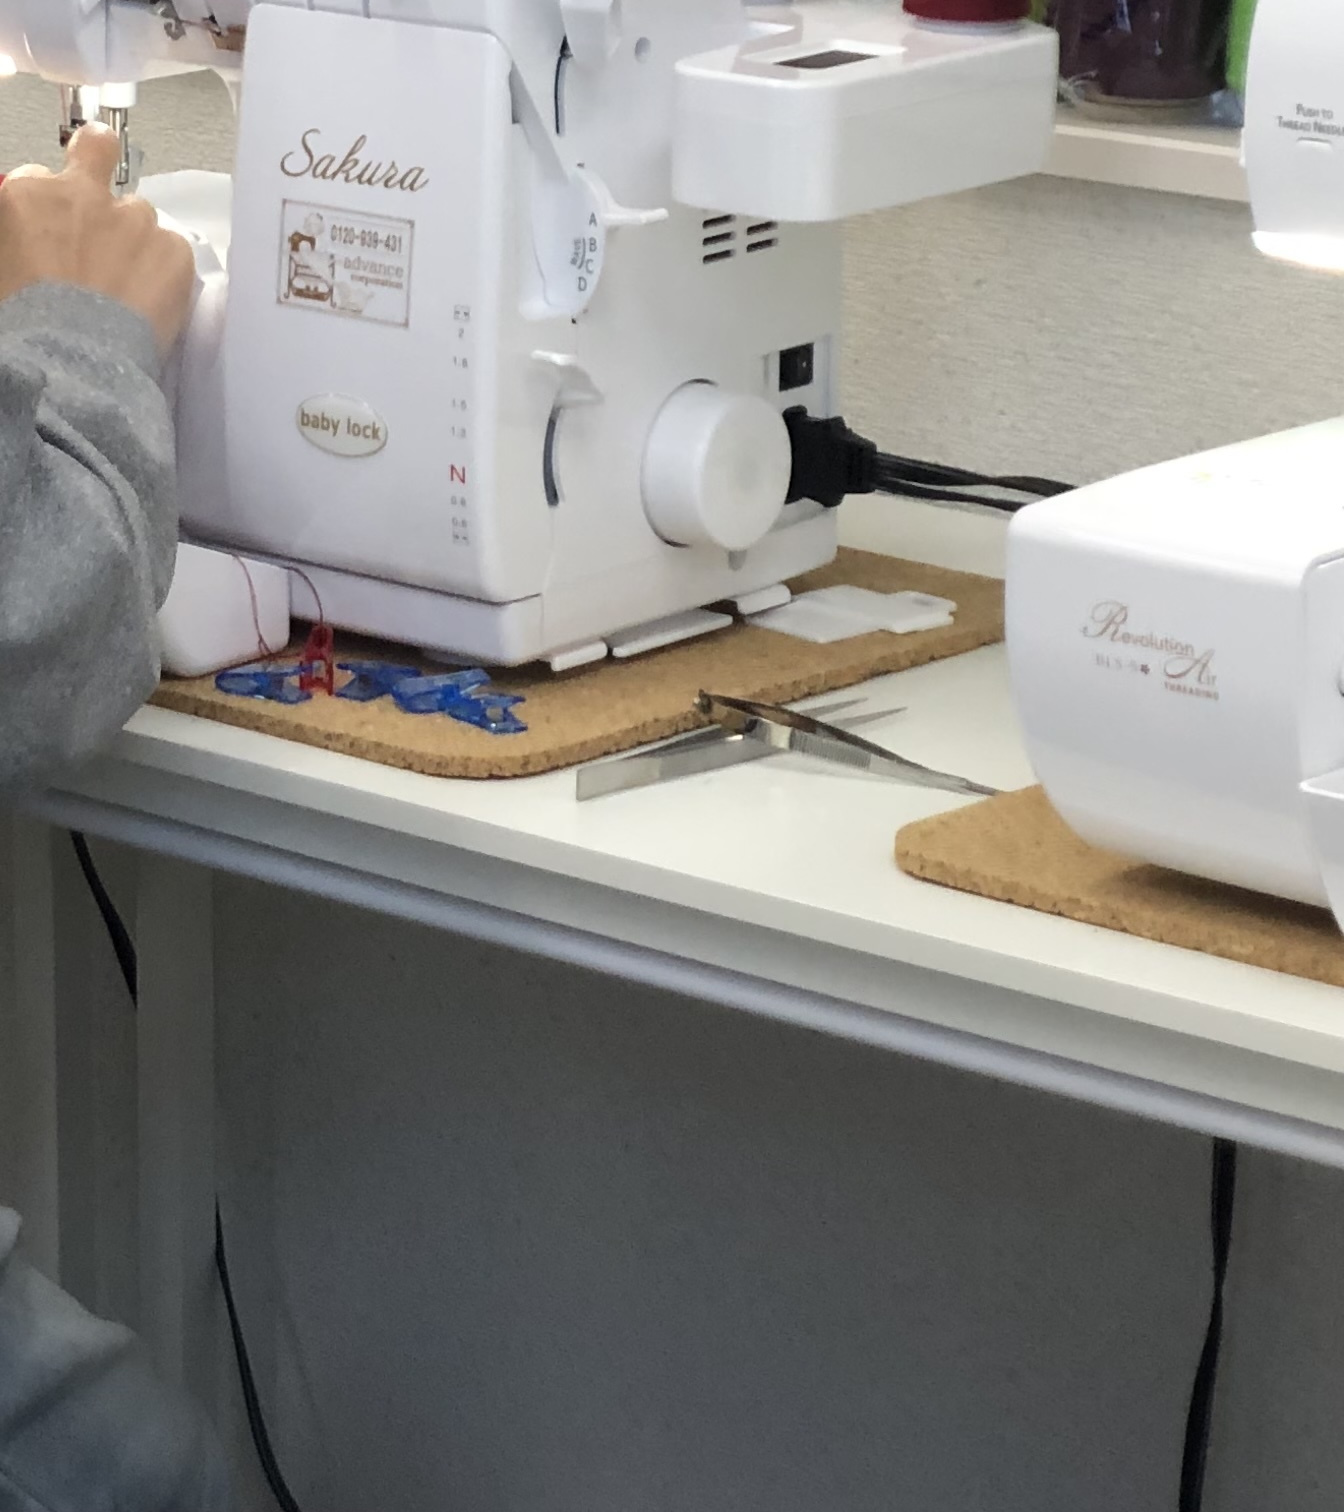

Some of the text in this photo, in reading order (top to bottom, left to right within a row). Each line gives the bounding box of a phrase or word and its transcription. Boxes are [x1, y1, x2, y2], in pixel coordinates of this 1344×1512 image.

[280, 128, 430, 192] Sakura
[588, 211, 598, 227] A
[588, 236, 598, 253] B
[585, 258, 595, 274] C
[577, 276, 588, 292] D
[300, 407, 381, 441] baby lock
[450, 464, 466, 484] N
[1080, 600, 1194, 656] Revolution
